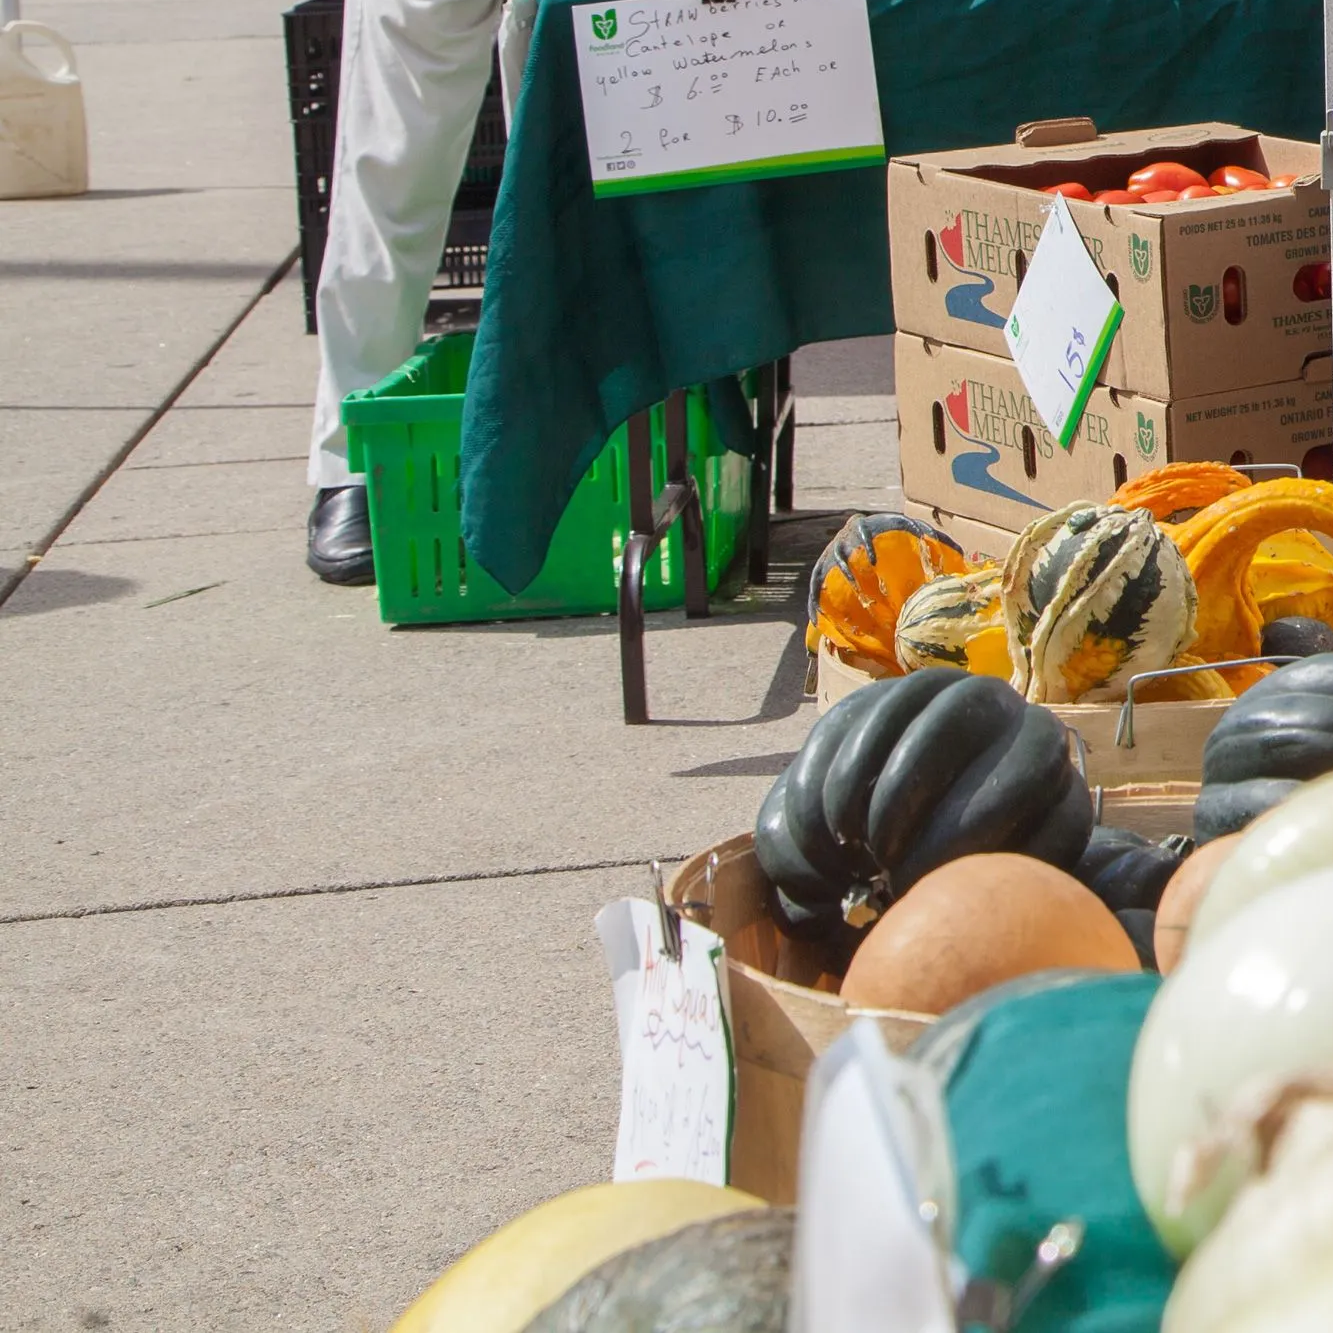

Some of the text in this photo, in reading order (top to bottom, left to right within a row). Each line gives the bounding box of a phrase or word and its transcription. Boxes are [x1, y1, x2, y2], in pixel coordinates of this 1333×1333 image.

[626, 30, 731, 57] Cantelope
[640, 85, 664, 109] $
[620, 130, 641, 154] 2
[725, 114, 744, 135] $
[962, 209, 1041, 251] THAMES
[1179, 224, 1205, 236] POIDS
[1207, 221, 1223, 232] NET
[1225, 219, 1236, 230] 25
[1272, 213, 1283, 225] kg
[1246, 229, 1294, 247] TOMATES
[1297, 227, 1316, 240] DES
[1285, 248, 1320, 260] GROWN
[1272, 310, 1322, 328] THAMES
[968, 379, 1047, 428] THAME
[1186, 411, 1203, 423] NET
[1204, 405, 1238, 421] WEIGHT
[1239, 404, 1250, 415] 25
[1285, 396, 1296, 408] kg
[1280, 408, 1324, 426] ONTARIO
[1292, 430, 1326, 443] GROWN
